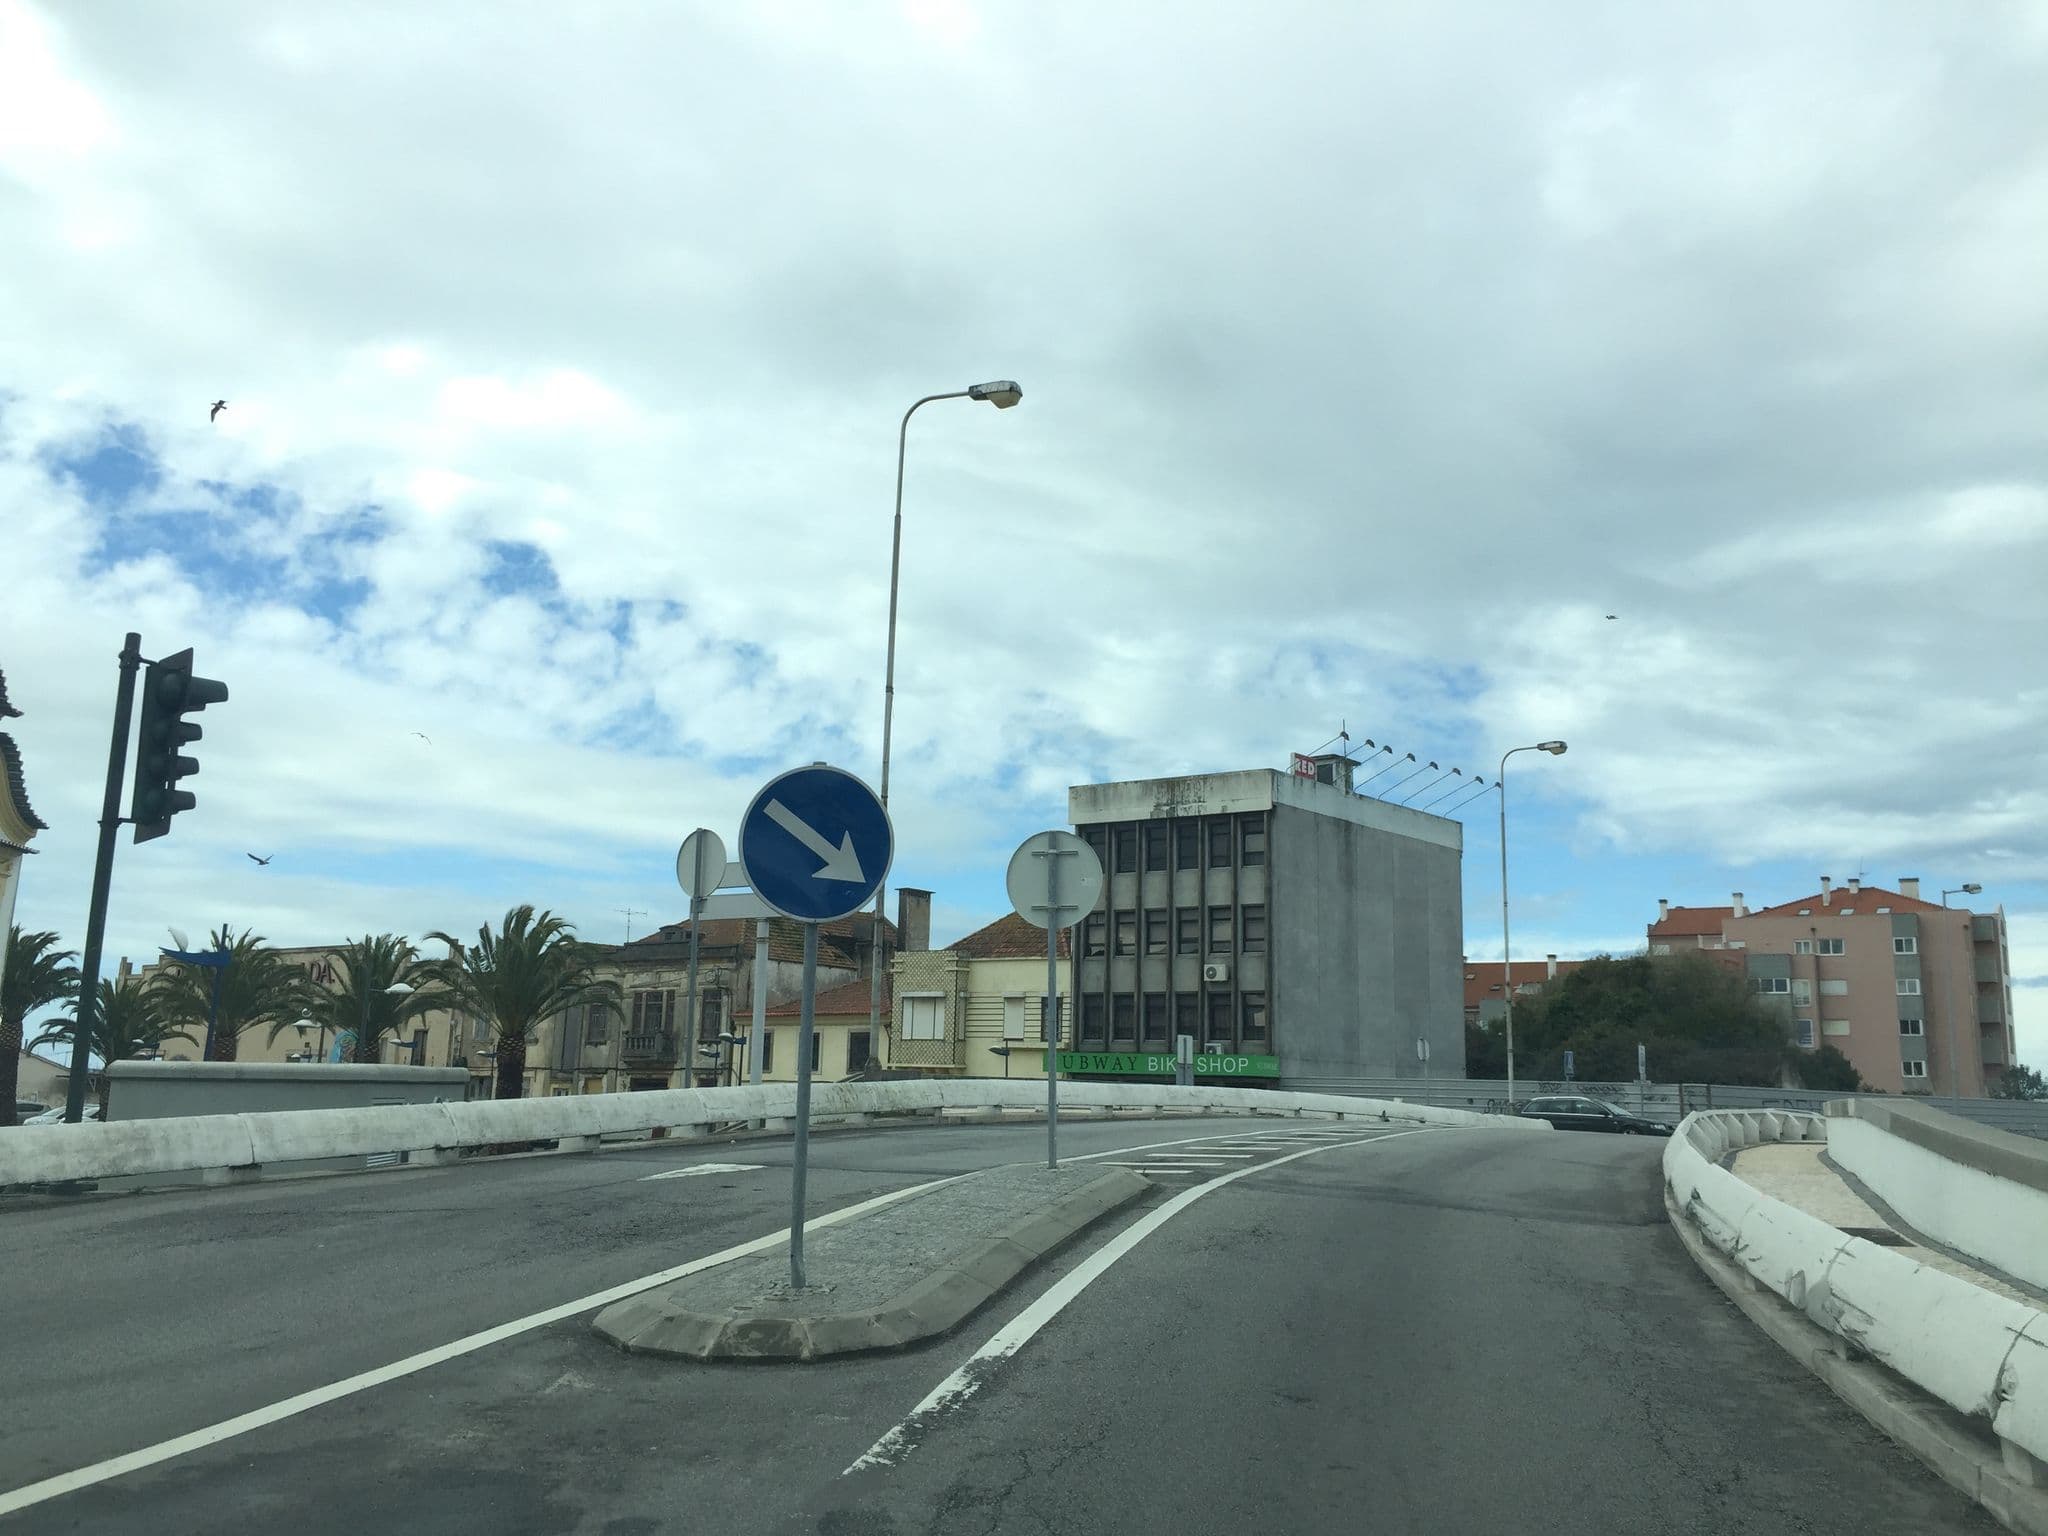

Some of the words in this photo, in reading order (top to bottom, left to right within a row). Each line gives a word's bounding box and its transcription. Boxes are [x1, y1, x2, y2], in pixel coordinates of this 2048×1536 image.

[1062, 1055, 1137, 1071] UBWAY
[1148, 1056, 1177, 1072] BIK
[1196, 1057, 1249, 1073] SHOP
